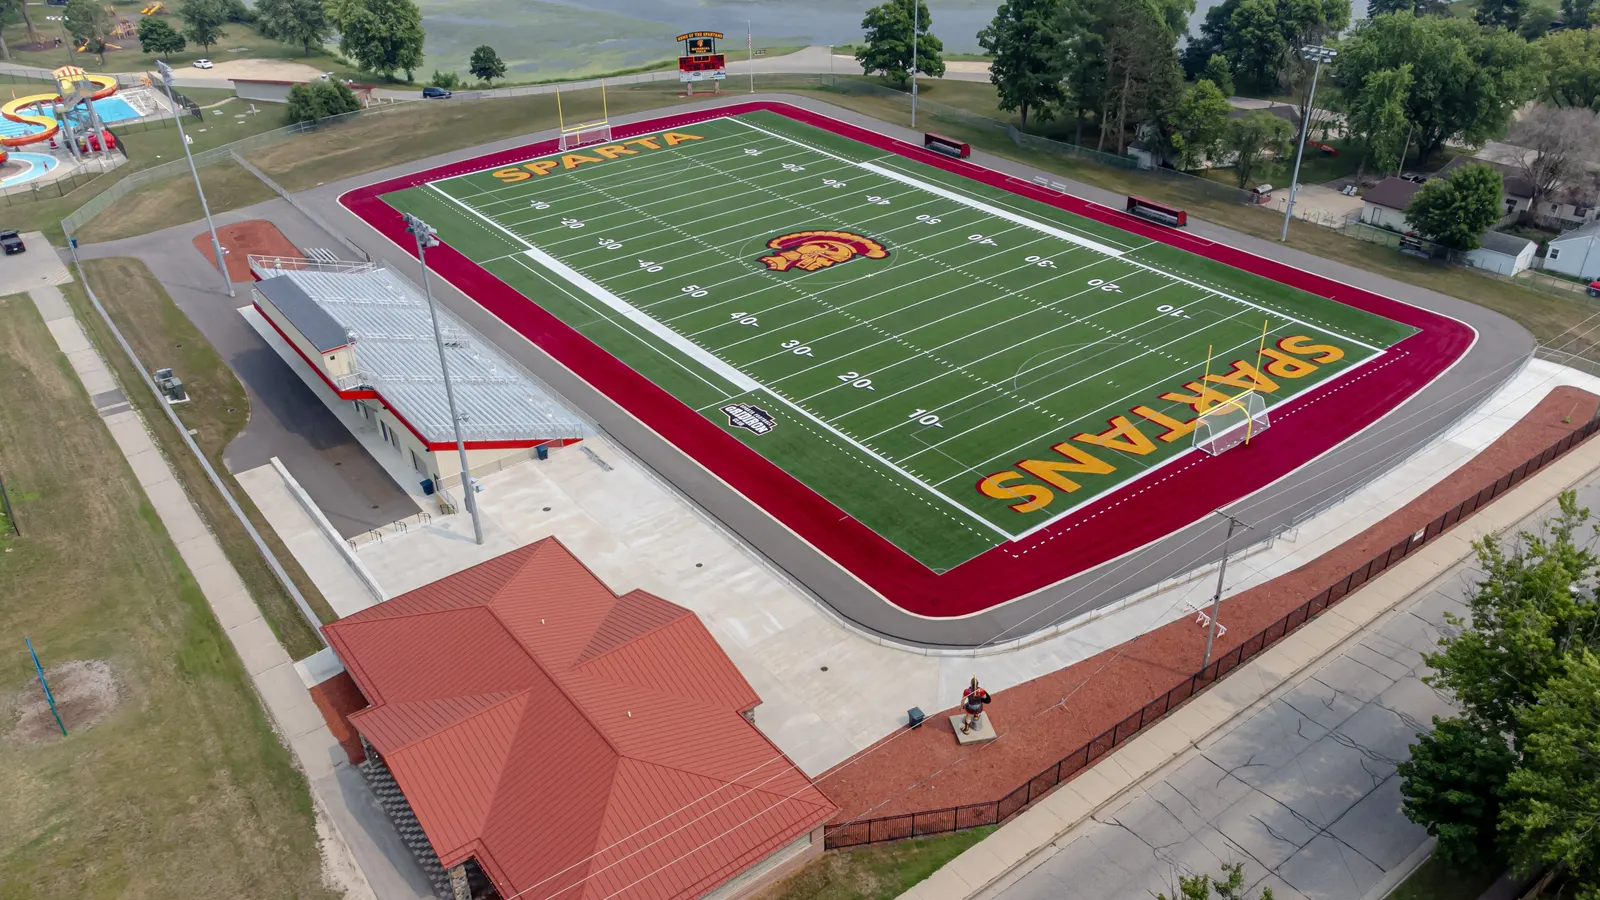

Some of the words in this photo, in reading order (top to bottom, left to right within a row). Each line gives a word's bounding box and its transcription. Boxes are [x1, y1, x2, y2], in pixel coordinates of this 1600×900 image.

[492, 132, 704, 183] SPARTA
[782, 163, 805, 172] 20
[823, 179, 846, 188] 30
[531, 201, 550, 210] 10
[867, 195, 890, 205] 40
[561, 218, 584, 229] 20
[916, 214, 941, 224] 50
[599, 238, 622, 250] 30
[968, 234, 994, 245] 40
[639, 261, 663, 273] 40
[1024, 255, 1053, 267] 30
[1087, 278, 1120, 292] 20
[681, 285, 708, 298] 50
[1156, 304, 1184, 317] 10
[730, 312, 757, 325] 40
[781, 340, 812, 355] 30
[838, 371, 871, 388] 20
[725, 406, 768, 433] GRIDIRON
[908, 408, 939, 426] 10
[975, 335, 1344, 513] SPARTANS
